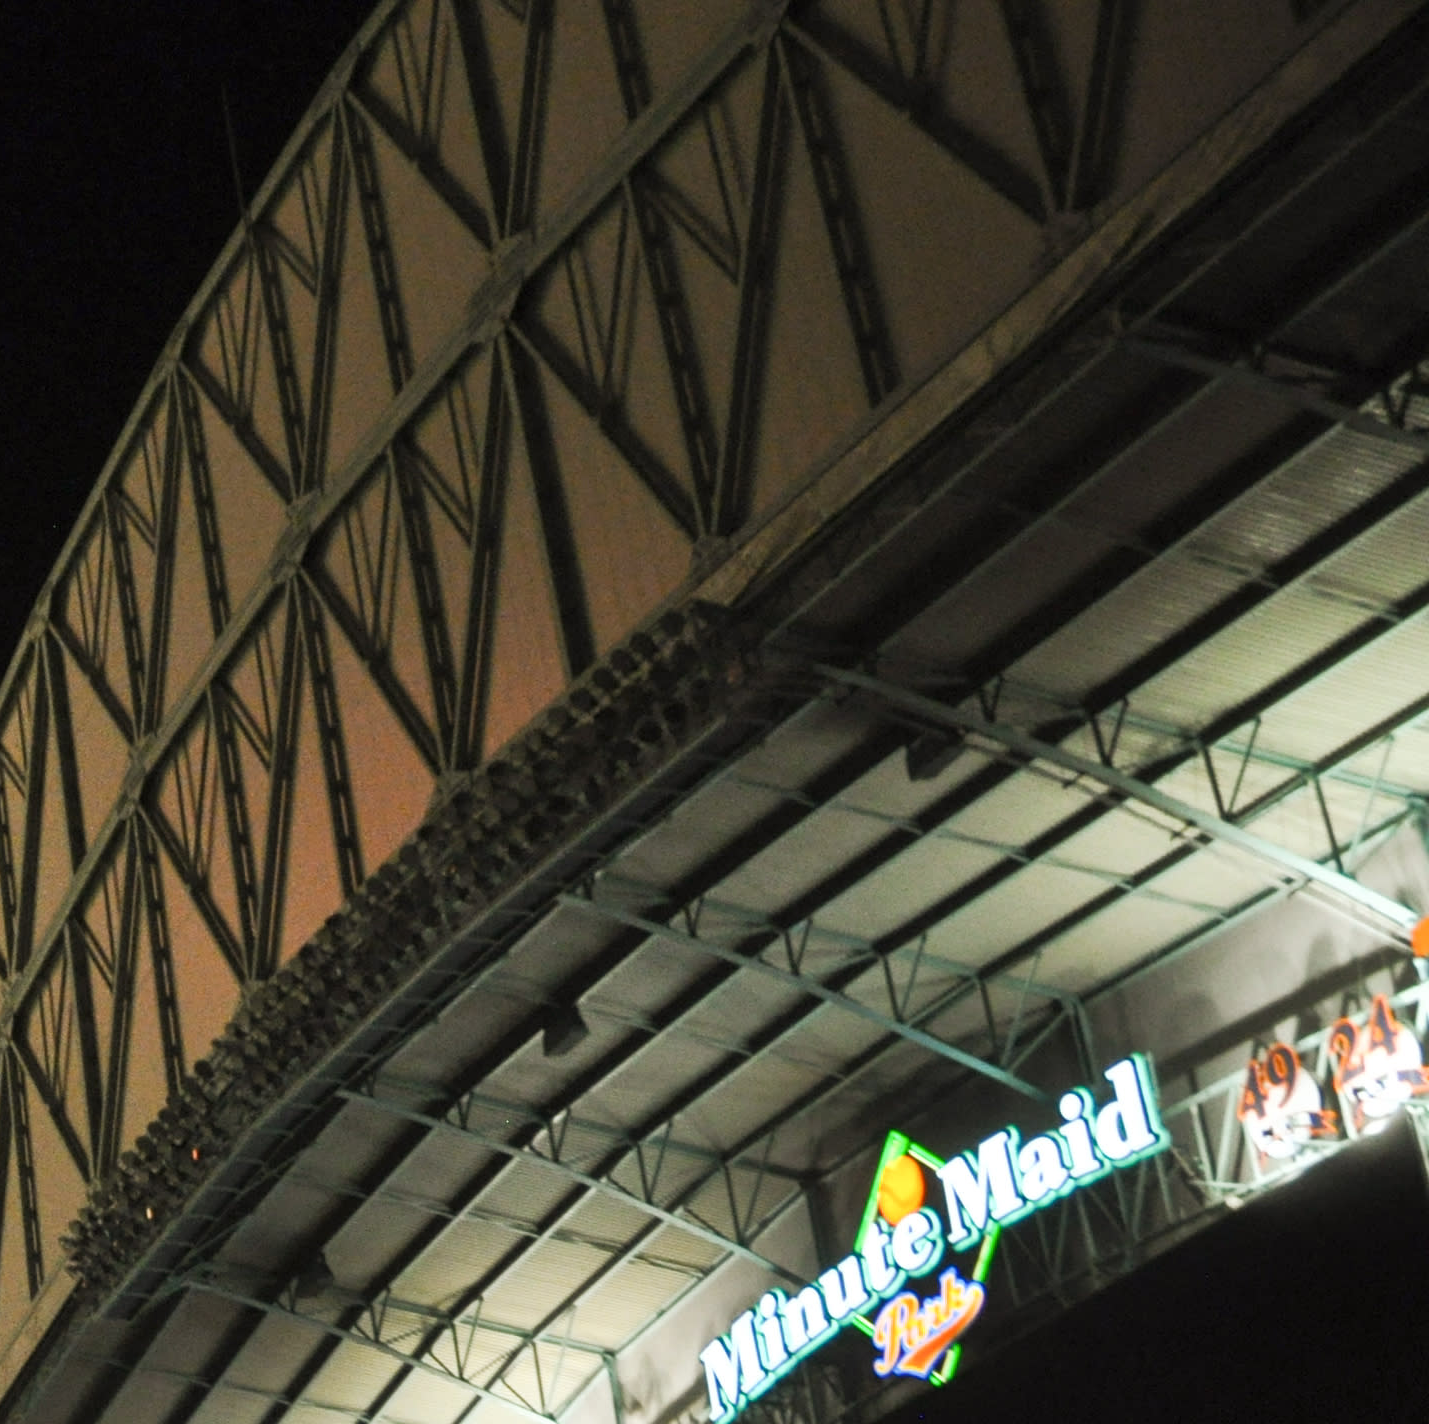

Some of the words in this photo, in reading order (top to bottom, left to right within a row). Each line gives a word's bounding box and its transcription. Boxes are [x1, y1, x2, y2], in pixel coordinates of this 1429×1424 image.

[1237, 1042, 1302, 1123] 49
[1329, 993, 1398, 1093] 24
[936, 1053, 1171, 1252] Maid
[873, 1266, 985, 1379] Park
